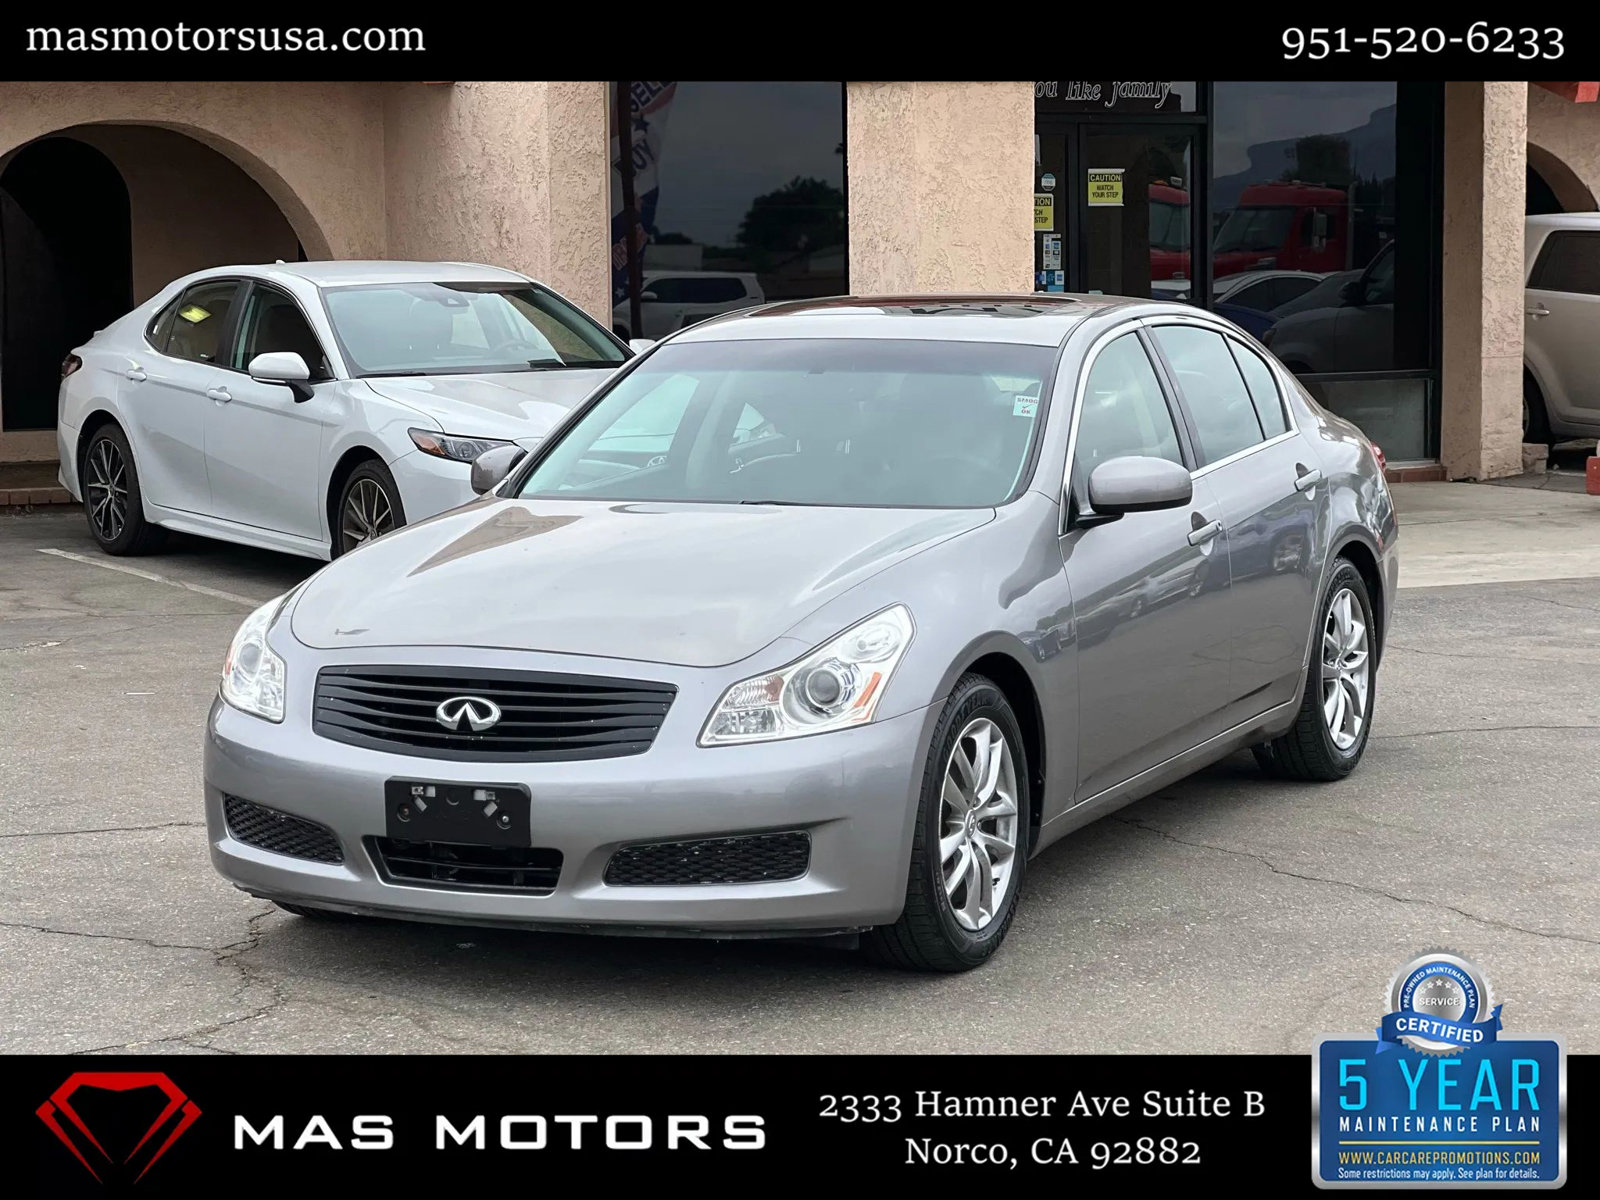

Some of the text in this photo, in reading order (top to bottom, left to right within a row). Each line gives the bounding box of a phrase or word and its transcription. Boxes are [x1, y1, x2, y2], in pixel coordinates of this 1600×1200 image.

[1034, 81, 1172, 109] ou like family
[1090, 174, 1121, 182] CAUTION
[1092, 191, 1119, 199] YOUR STEP
